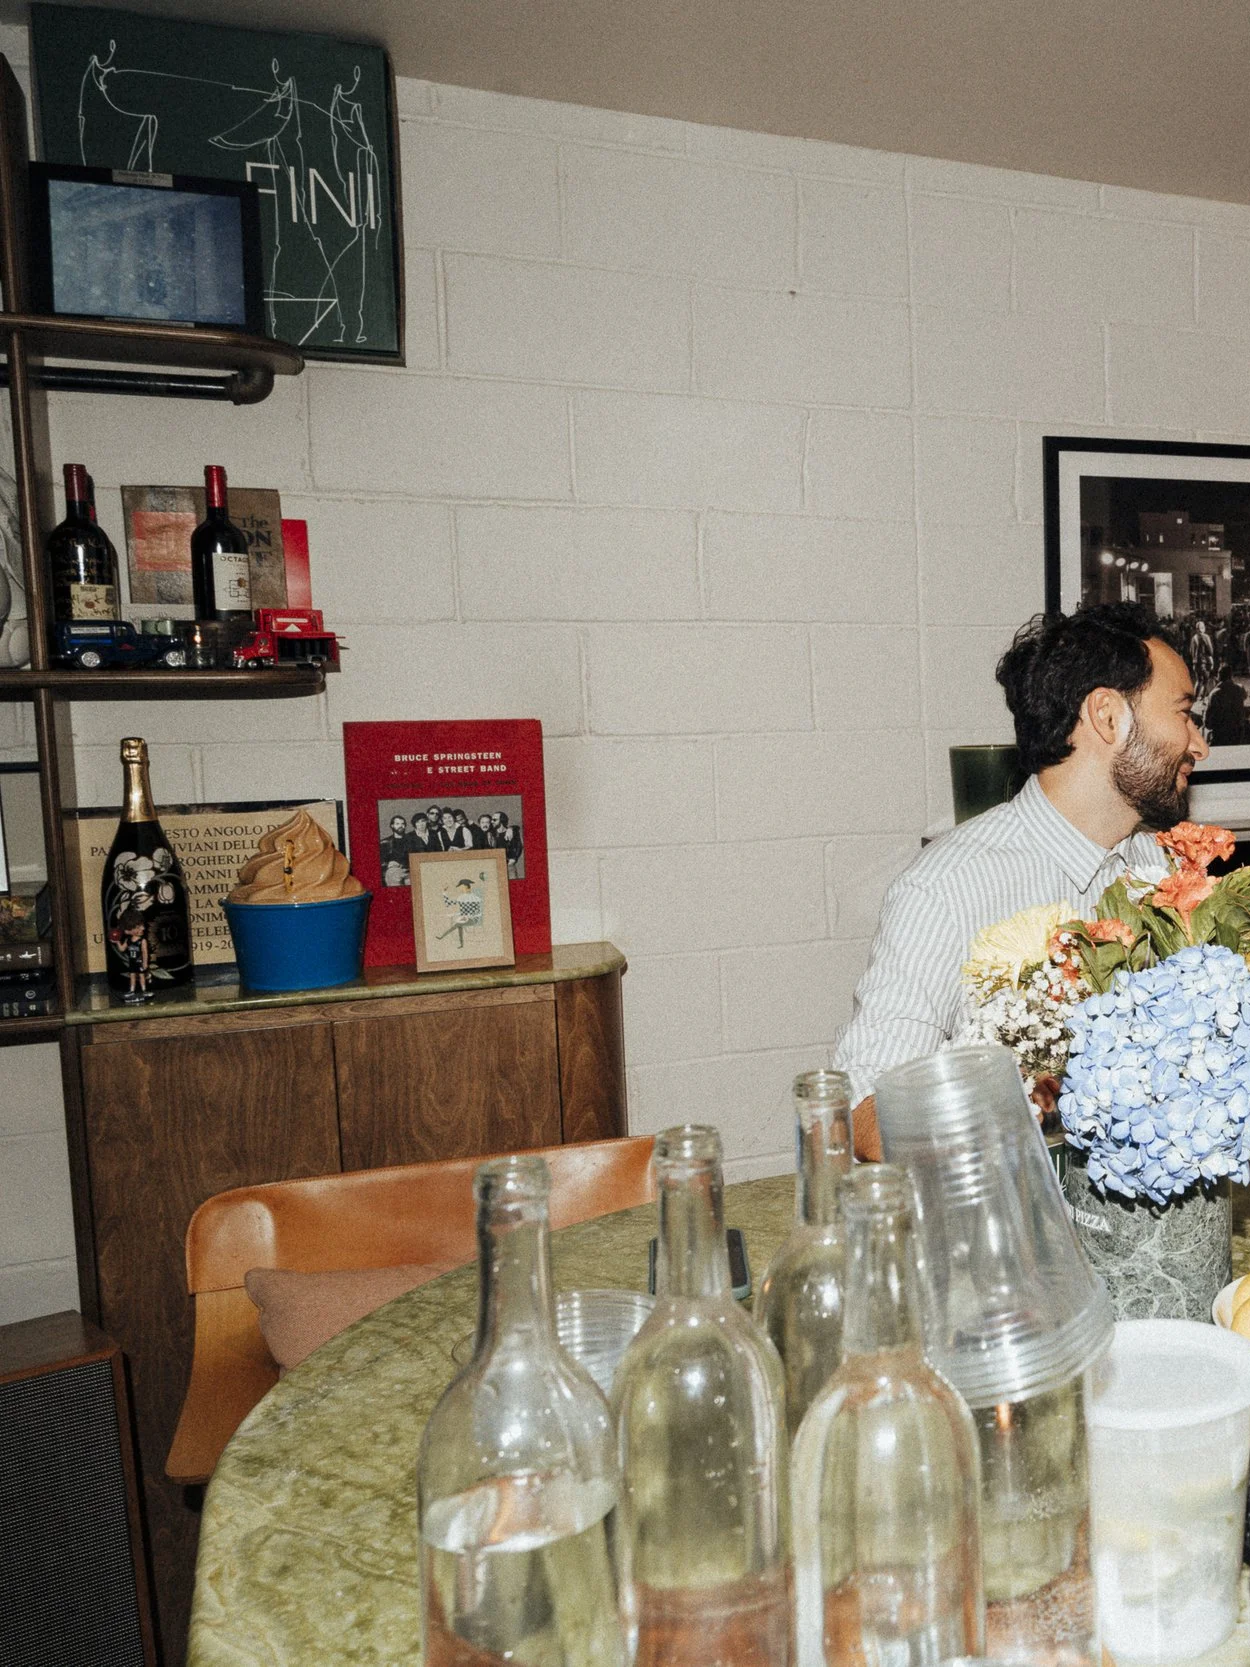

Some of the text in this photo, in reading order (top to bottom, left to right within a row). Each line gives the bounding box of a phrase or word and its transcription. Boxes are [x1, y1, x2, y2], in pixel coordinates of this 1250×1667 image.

[394, 752, 502, 762] BRUCE SPRINGSTEEN
[427, 764, 507, 774] E STREET BAND
[167, 828, 199, 839] ESTO
[203, 824, 263, 837] ANGOLO
[172, 841, 219, 853] IVIANI
[222, 839, 260, 851] DELL
[180, 855, 251, 867] ROGHERIA
[195, 868, 232, 880] ANNI
[1075, 1207, 1111, 1233] PIZZA
